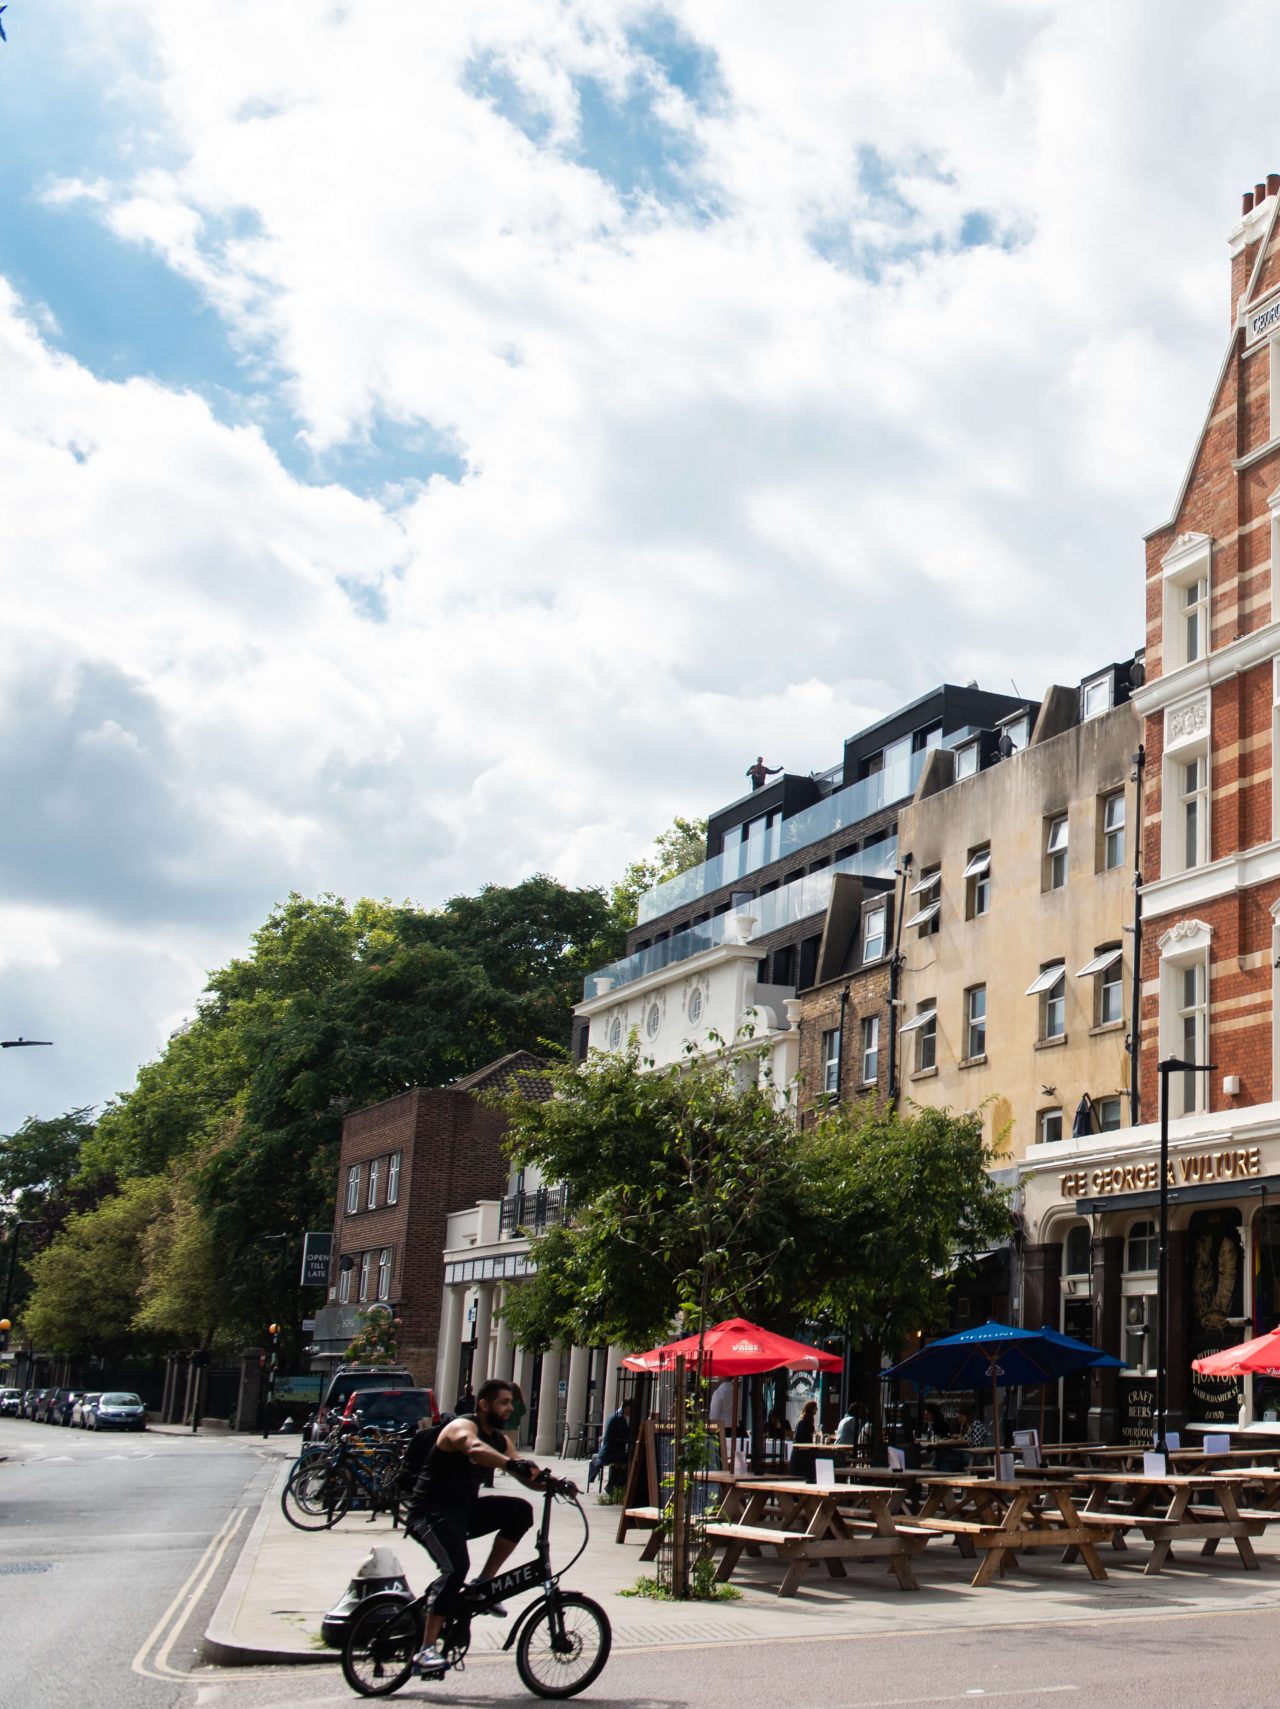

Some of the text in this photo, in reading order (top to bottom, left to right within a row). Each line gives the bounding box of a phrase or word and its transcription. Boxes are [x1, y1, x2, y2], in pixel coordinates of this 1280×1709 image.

[1058, 1171, 1087, 1196] THE
[1092, 1162, 1158, 1192] GEORGE
[1178, 1147, 1260, 1183] VULTURE
[1192, 1369, 1238, 1385] HOXTON
[1128, 1390, 1154, 1404] CRAFT
[1193, 1386, 1233, 1403] HABERDASHER
[1128, 1406, 1152, 1418] BEERS
